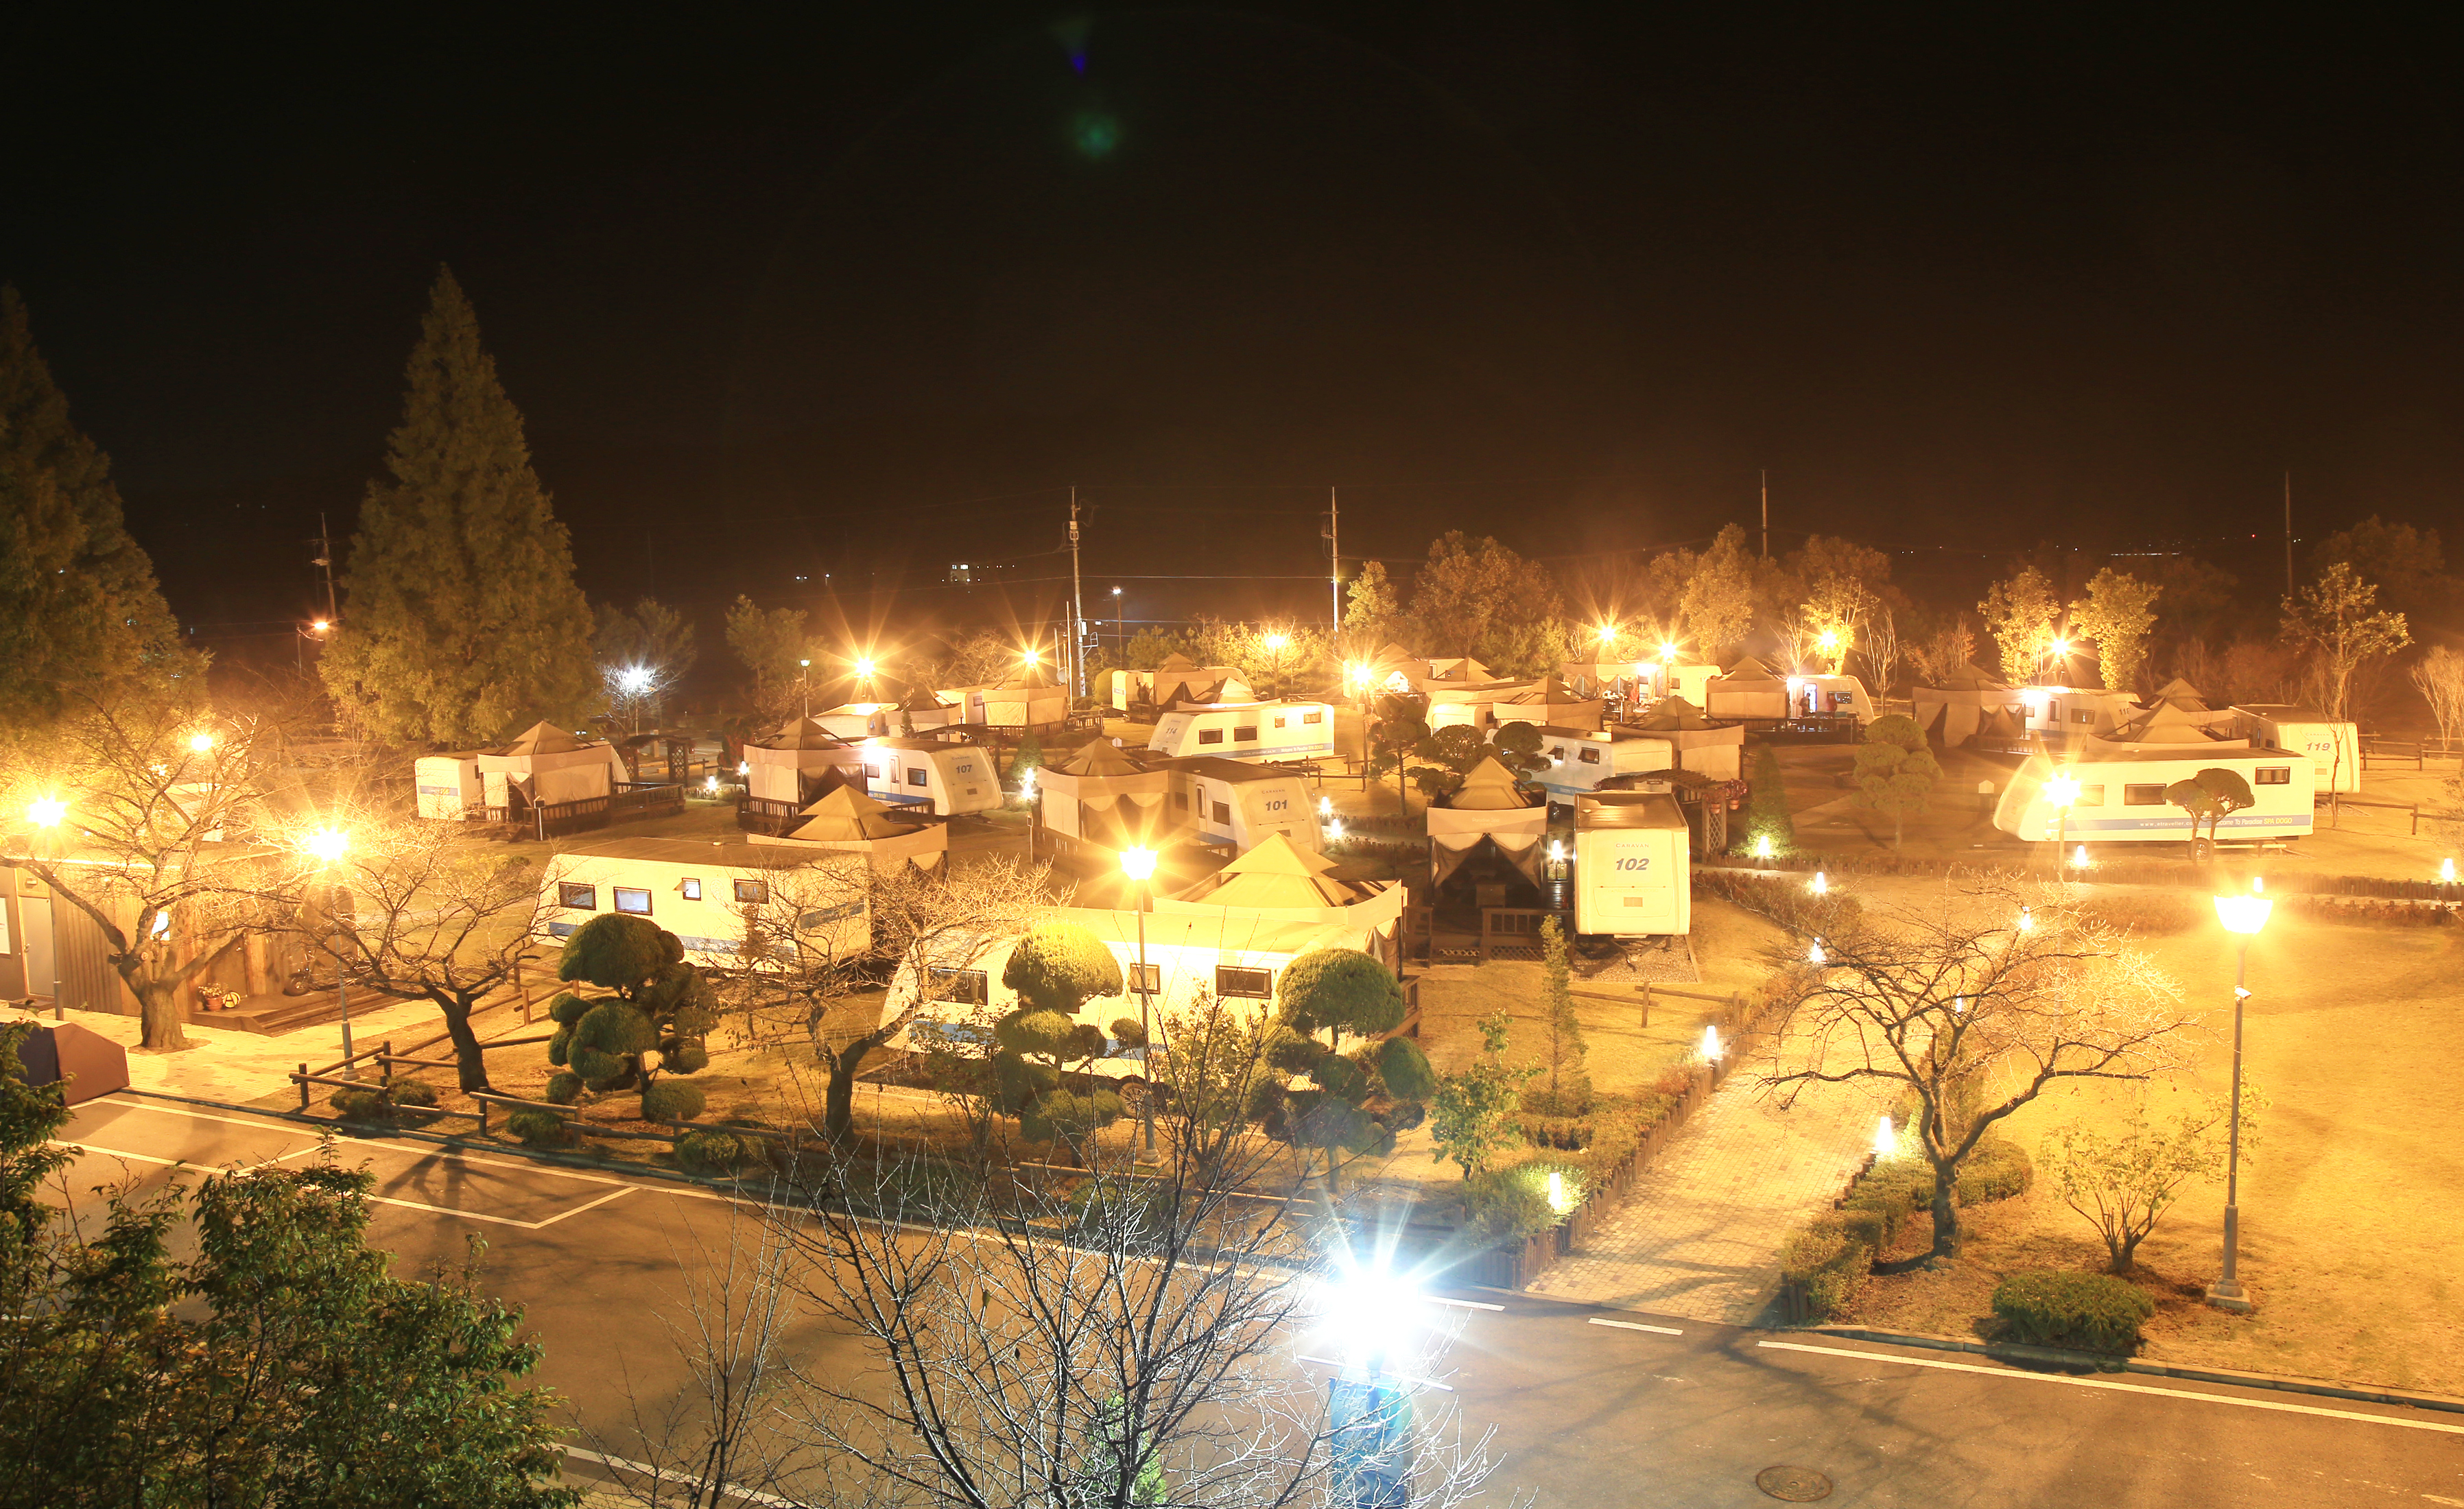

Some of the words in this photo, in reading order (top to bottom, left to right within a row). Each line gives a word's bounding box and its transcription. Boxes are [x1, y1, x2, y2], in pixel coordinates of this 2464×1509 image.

[956, 764, 972, 774] 107
[1266, 799, 1287, 811] 101
[1615, 858, 1649, 870] 102
